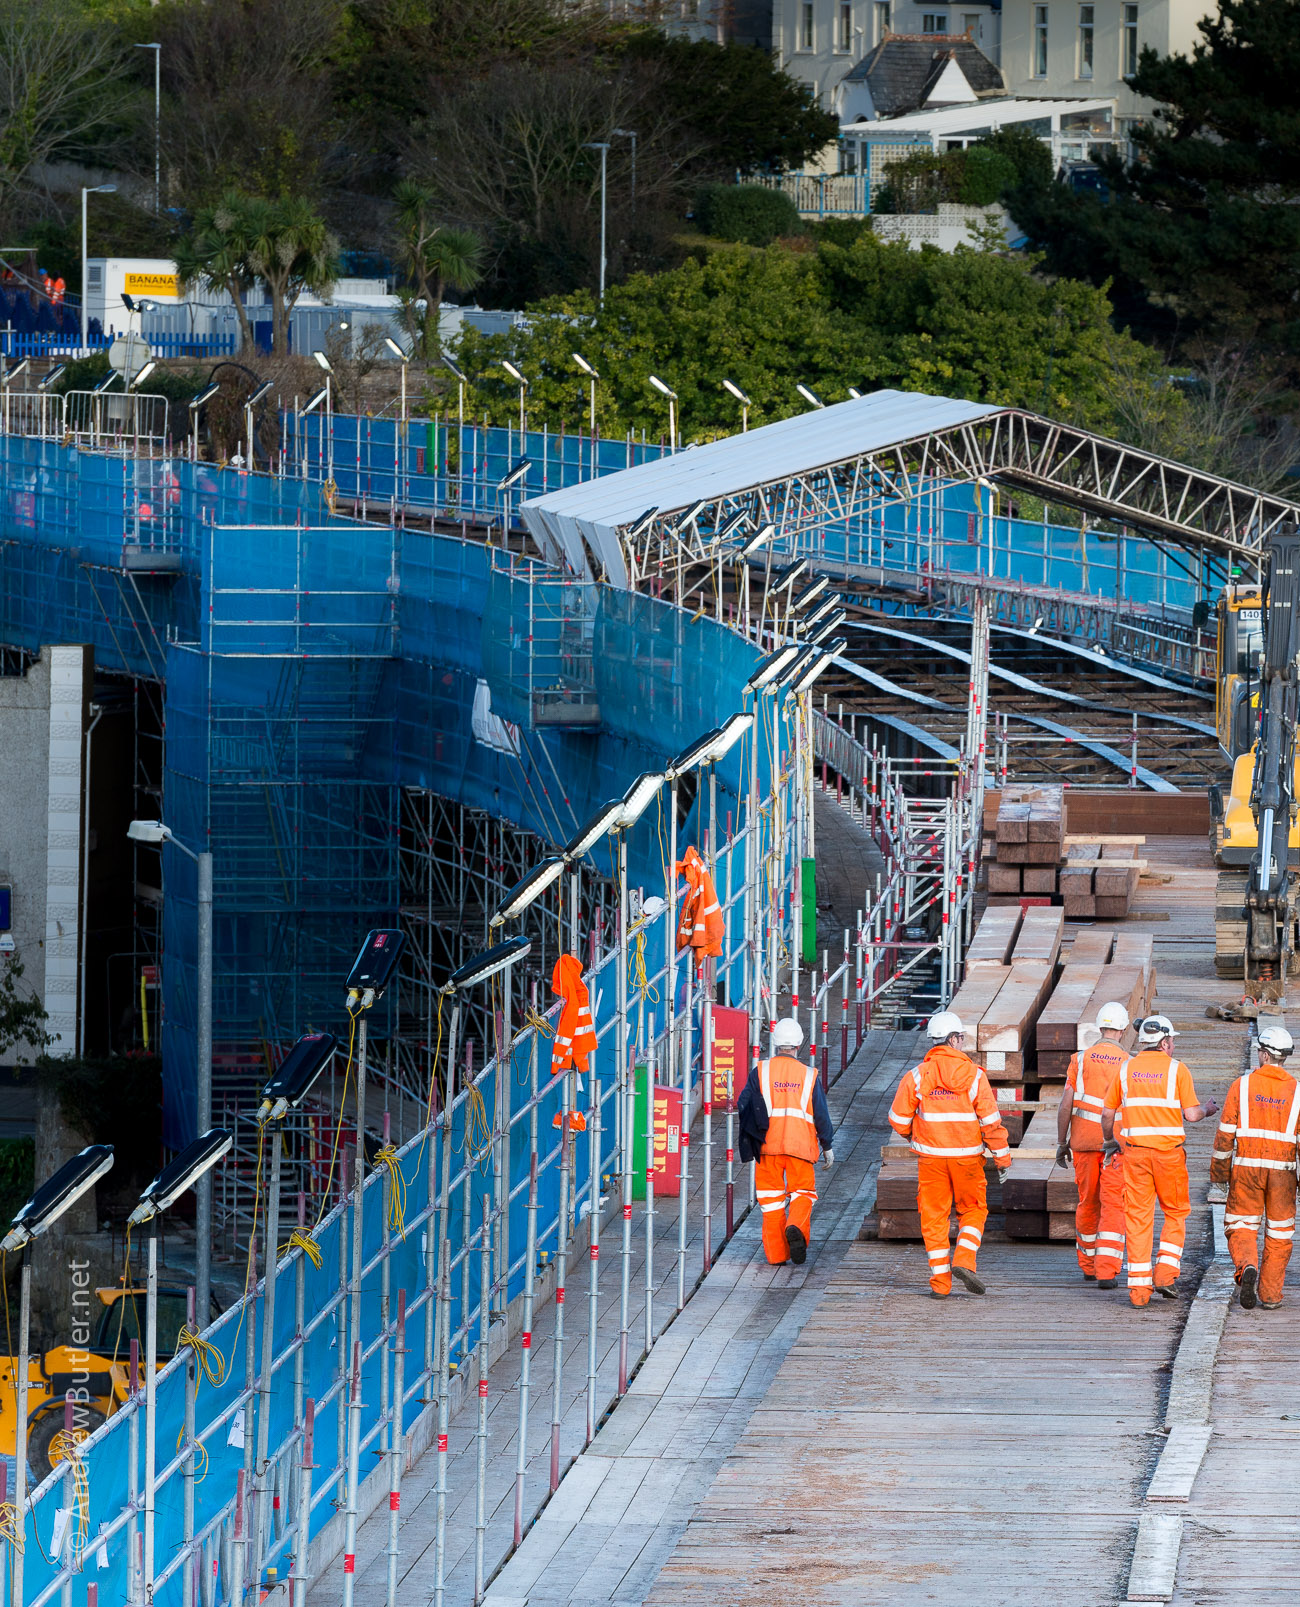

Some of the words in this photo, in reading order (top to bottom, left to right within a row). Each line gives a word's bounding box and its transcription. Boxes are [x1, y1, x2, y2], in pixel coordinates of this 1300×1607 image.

[1090, 1052, 1122, 1062] Stobart
[1131, 1071, 1164, 1079] Stobart
[773, 1081, 801, 1089] Stobart
[1255, 1094, 1286, 1105] Stobart
